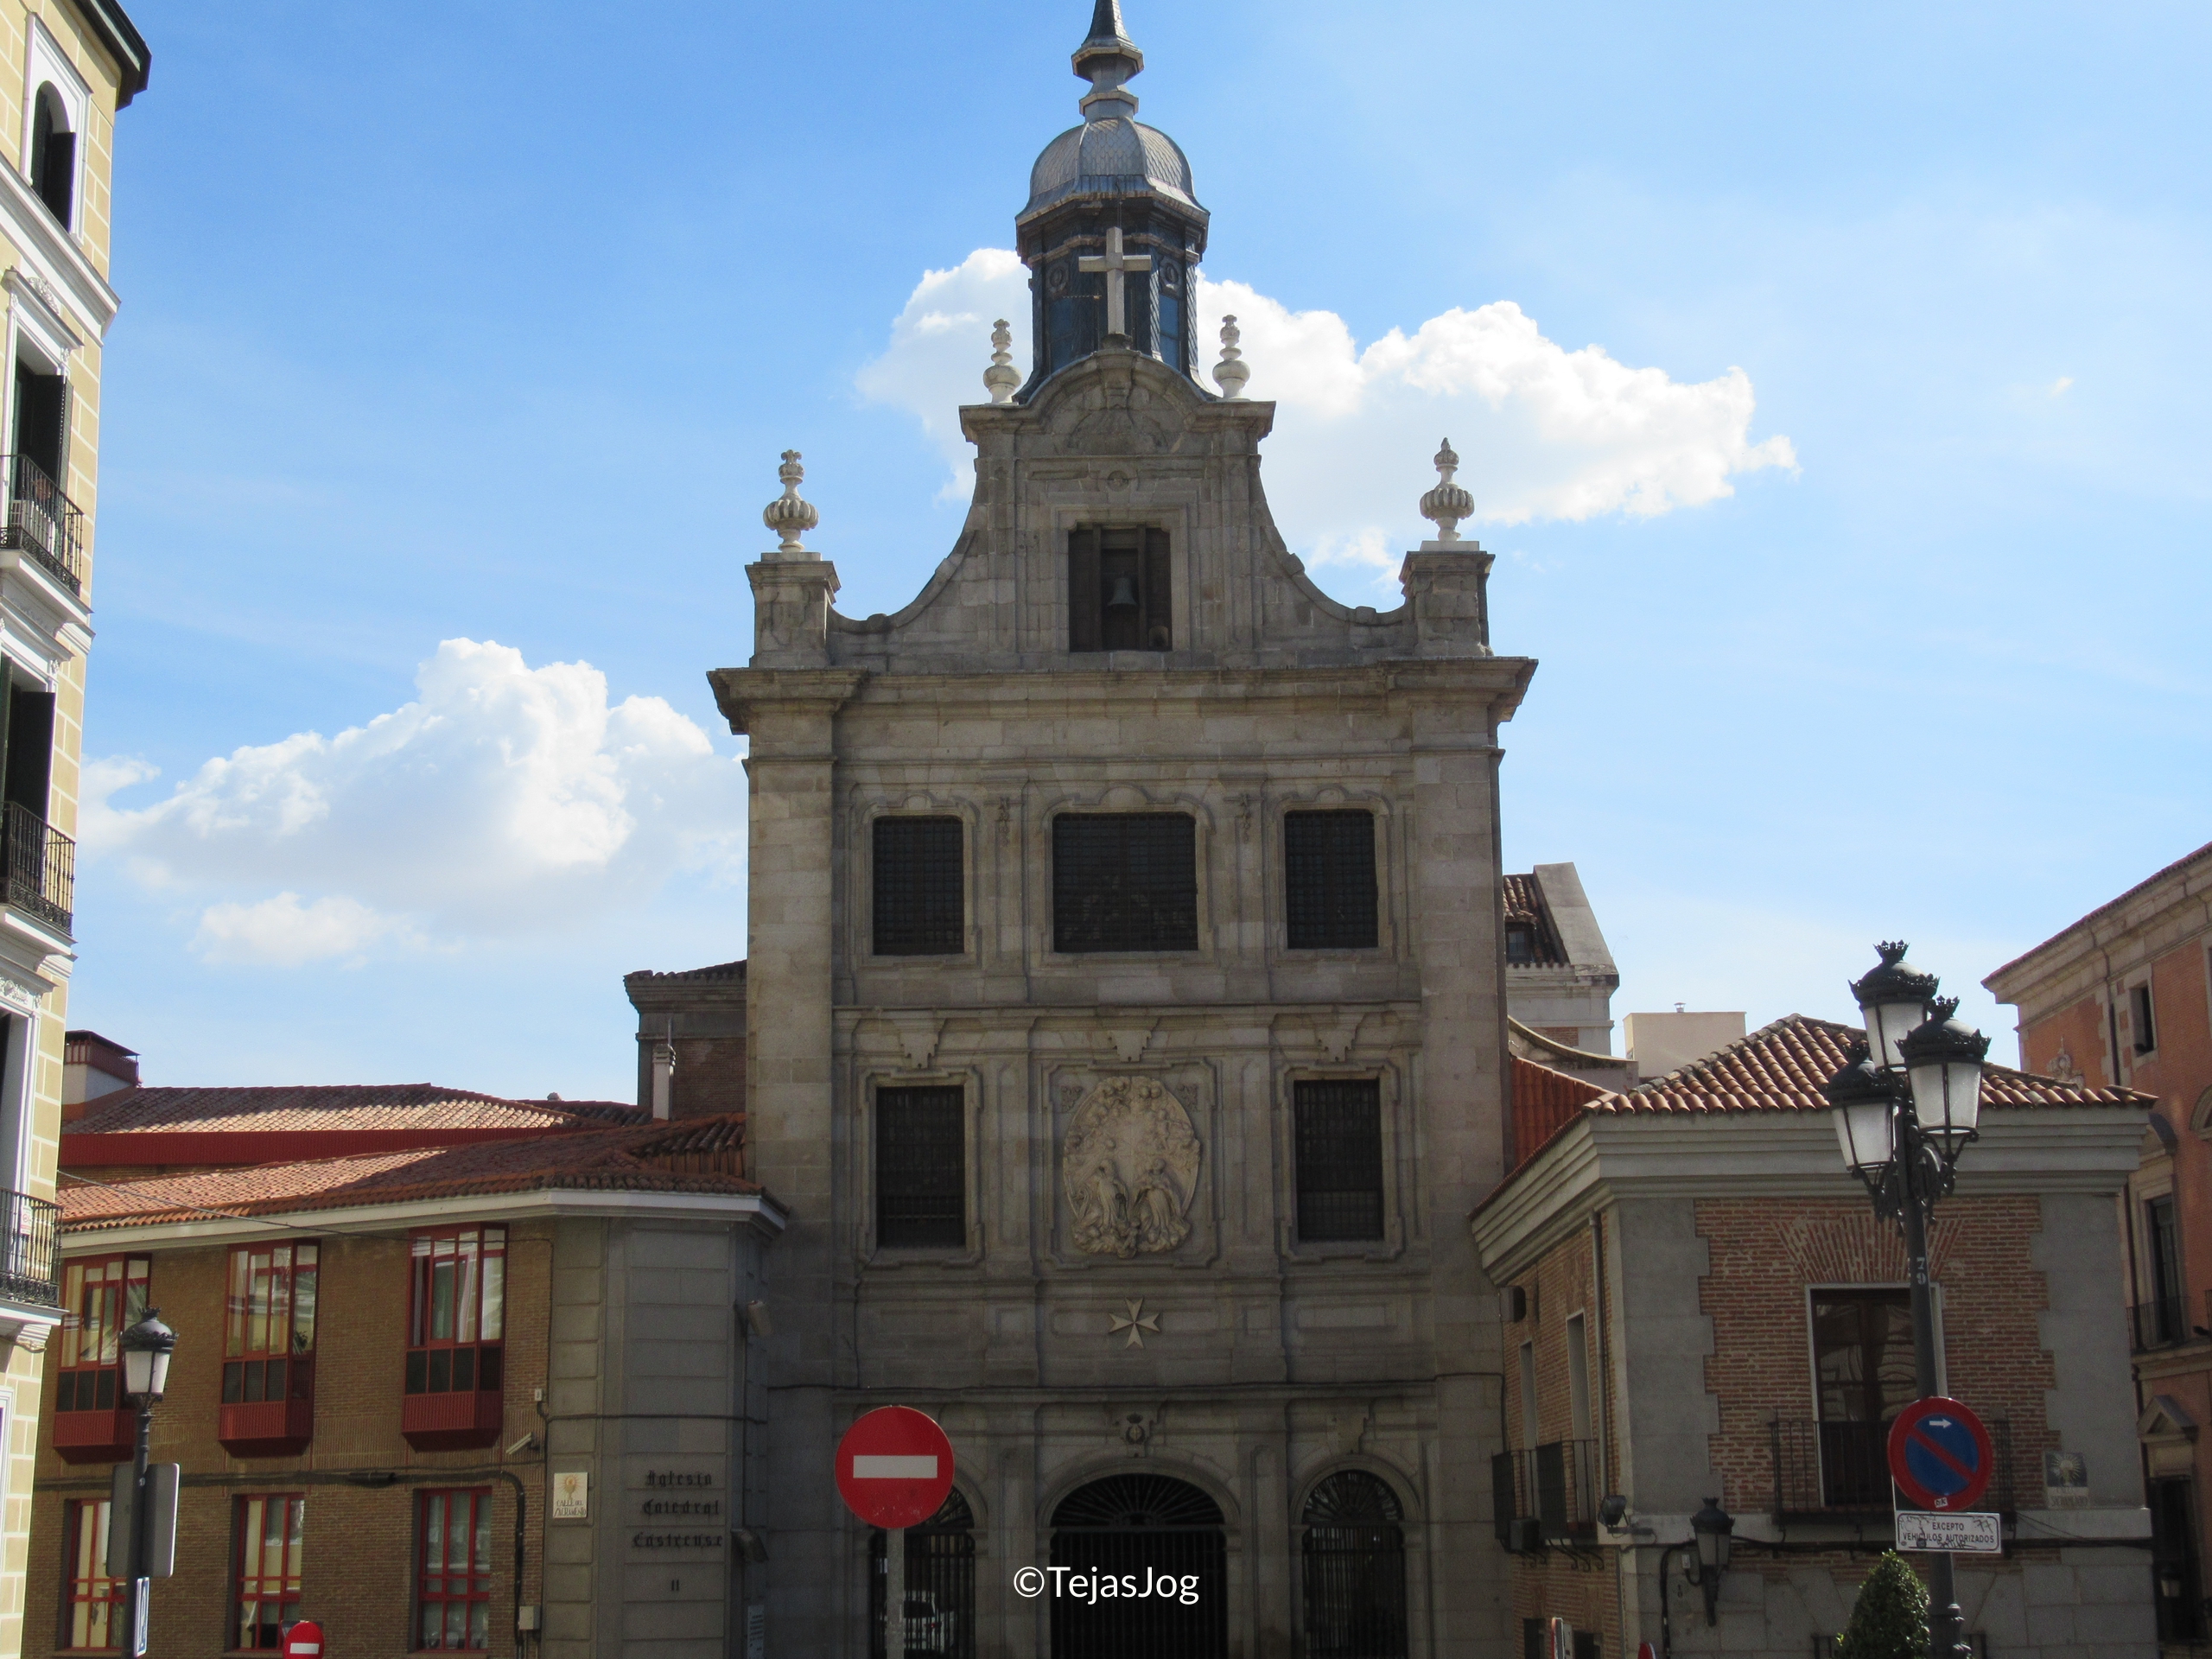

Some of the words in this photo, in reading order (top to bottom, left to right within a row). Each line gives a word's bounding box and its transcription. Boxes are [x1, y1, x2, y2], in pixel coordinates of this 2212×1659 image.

[643, 1498, 719, 1516] Catedral
[1932, 1522, 1964, 1531] EXCEPTO
[1903, 1532, 1942, 1541] VEHICULOS
[1945, 1535, 1994, 1543] AUTORIZADOS
